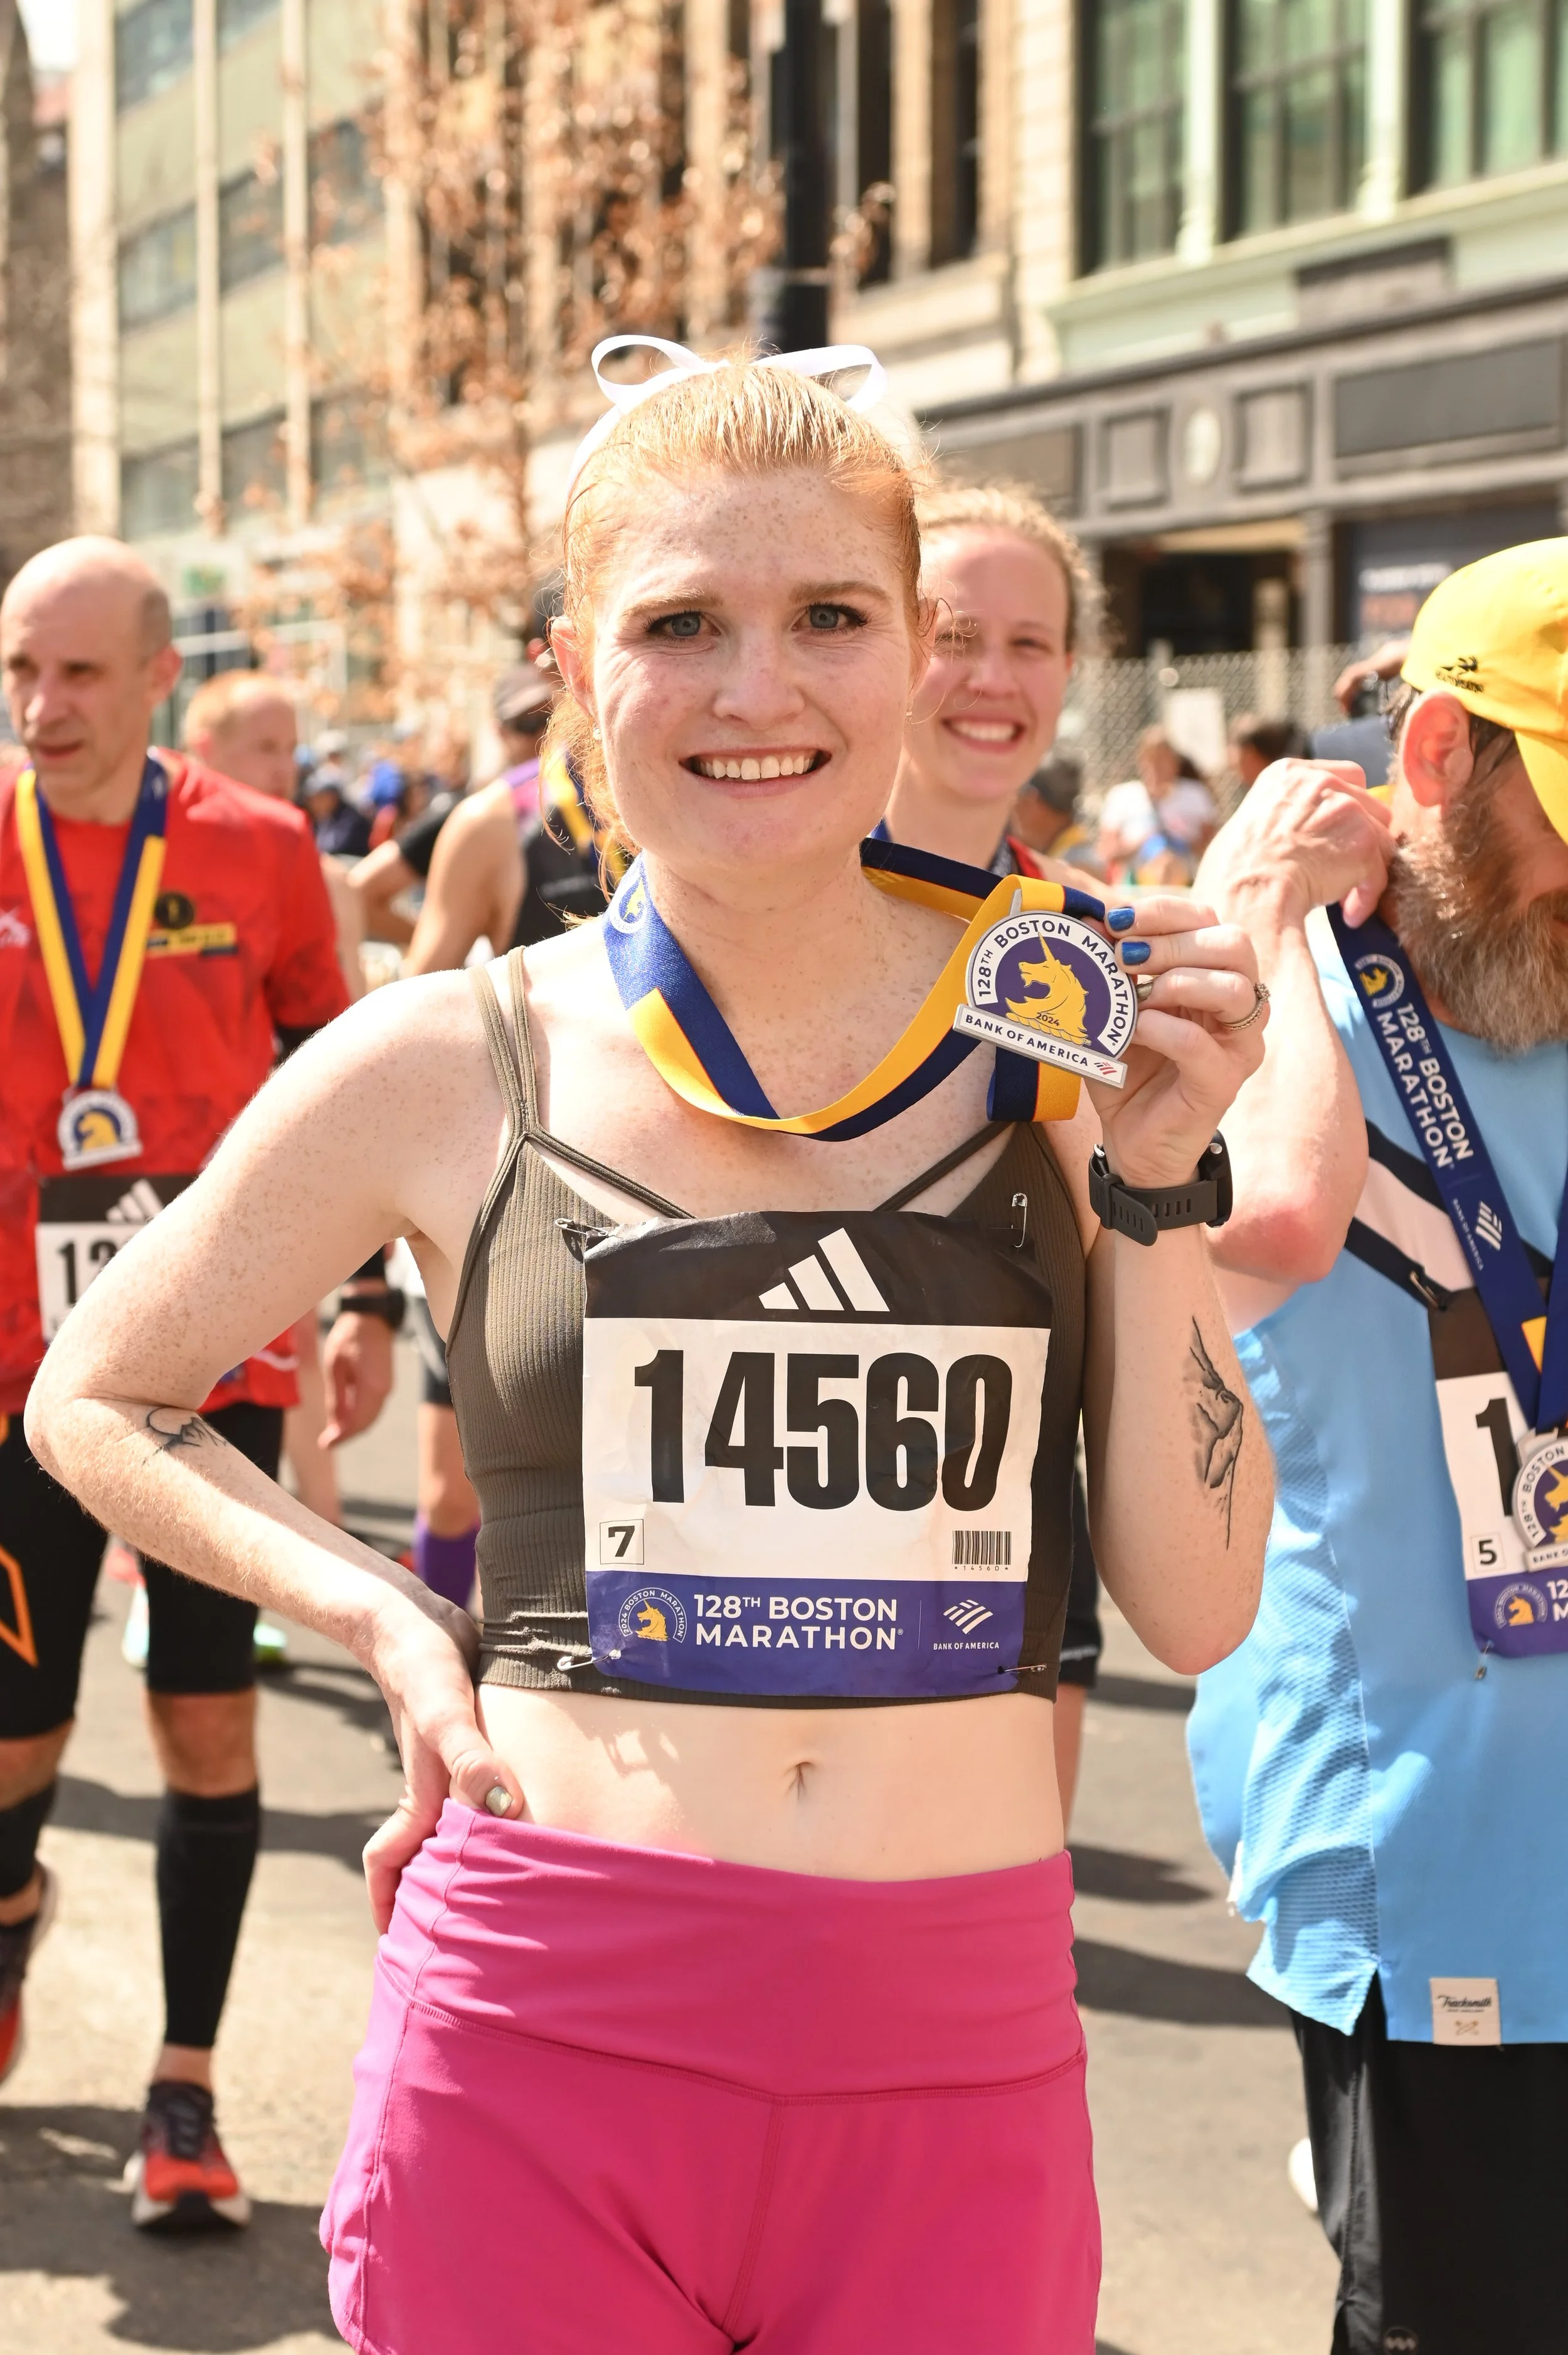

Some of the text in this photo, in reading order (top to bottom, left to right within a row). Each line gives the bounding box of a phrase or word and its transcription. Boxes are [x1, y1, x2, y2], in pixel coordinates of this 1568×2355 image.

[978, 950, 993, 996] 128TH
[994, 920, 1071, 948] BOSTON
[966, 1014, 1088, 1066] BANK OF AMERICA
[1036, 1012, 1060, 1026] 2024
[1419, 1057, 1474, 1160] BOSTON
[634, 1349, 1013, 1512] 14560
[1522, 1446, 1565, 1492] BOSTON
[608, 1526, 635, 1557] 7
[1478, 1539, 1498, 1565] 5
[1533, 1551, 1559, 1564] BANK
[621, 1590, 685, 1637] 2024 BOSTON MARATHON
[694, 1594, 897, 1621] 128TH BOSTON
